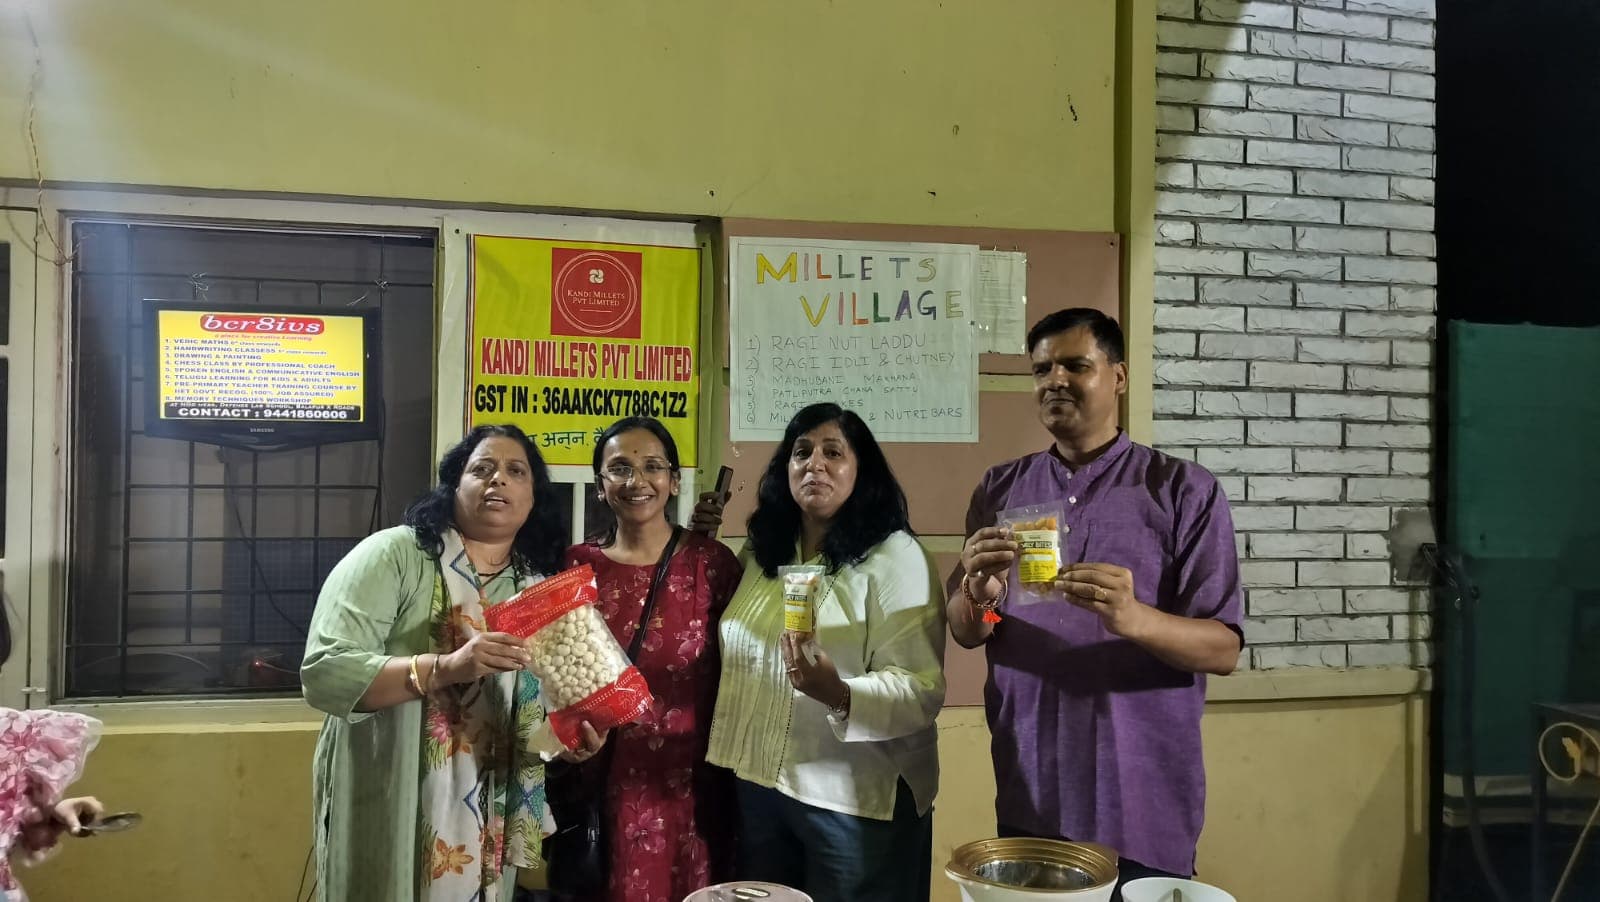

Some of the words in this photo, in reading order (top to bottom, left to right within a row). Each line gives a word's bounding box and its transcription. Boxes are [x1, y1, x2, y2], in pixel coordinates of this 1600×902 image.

[756, 252, 937, 284] MILLETS
[567, 289, 592, 298] KANDI
[593, 291, 625, 299] MILLETS
[572, 297, 587, 305] PVT
[589, 298, 620, 306] LIMITED
[800, 289, 964, 327] VILLAGE
[771, 335, 818, 350] RAGI
[829, 336, 862, 350] NUT
[871, 332, 926, 349] LADDU
[481, 338, 530, 376] KANDI
[534, 340, 598, 378] MILLETS
[601, 343, 631, 380] PVT
[634, 344, 693, 382] LIMITED
[772, 357, 821, 372] RAGI
[828, 355, 870, 369] IDLI
[879, 352, 889, 367] &
[895, 352, 955, 366] CHUTNEY
[772, 374, 844, 387] MADHUBANI
[863, 372, 917, 384] MAKHANA
[842, 385, 873, 395] CHANA
[475, 384, 507, 412] GST
[511, 386, 528, 413] IN
[542, 387, 687, 418] 36AAKCK7788C1Z2
[775, 401, 806, 411] RAGI
[178, 407, 251, 418] CONTACT
